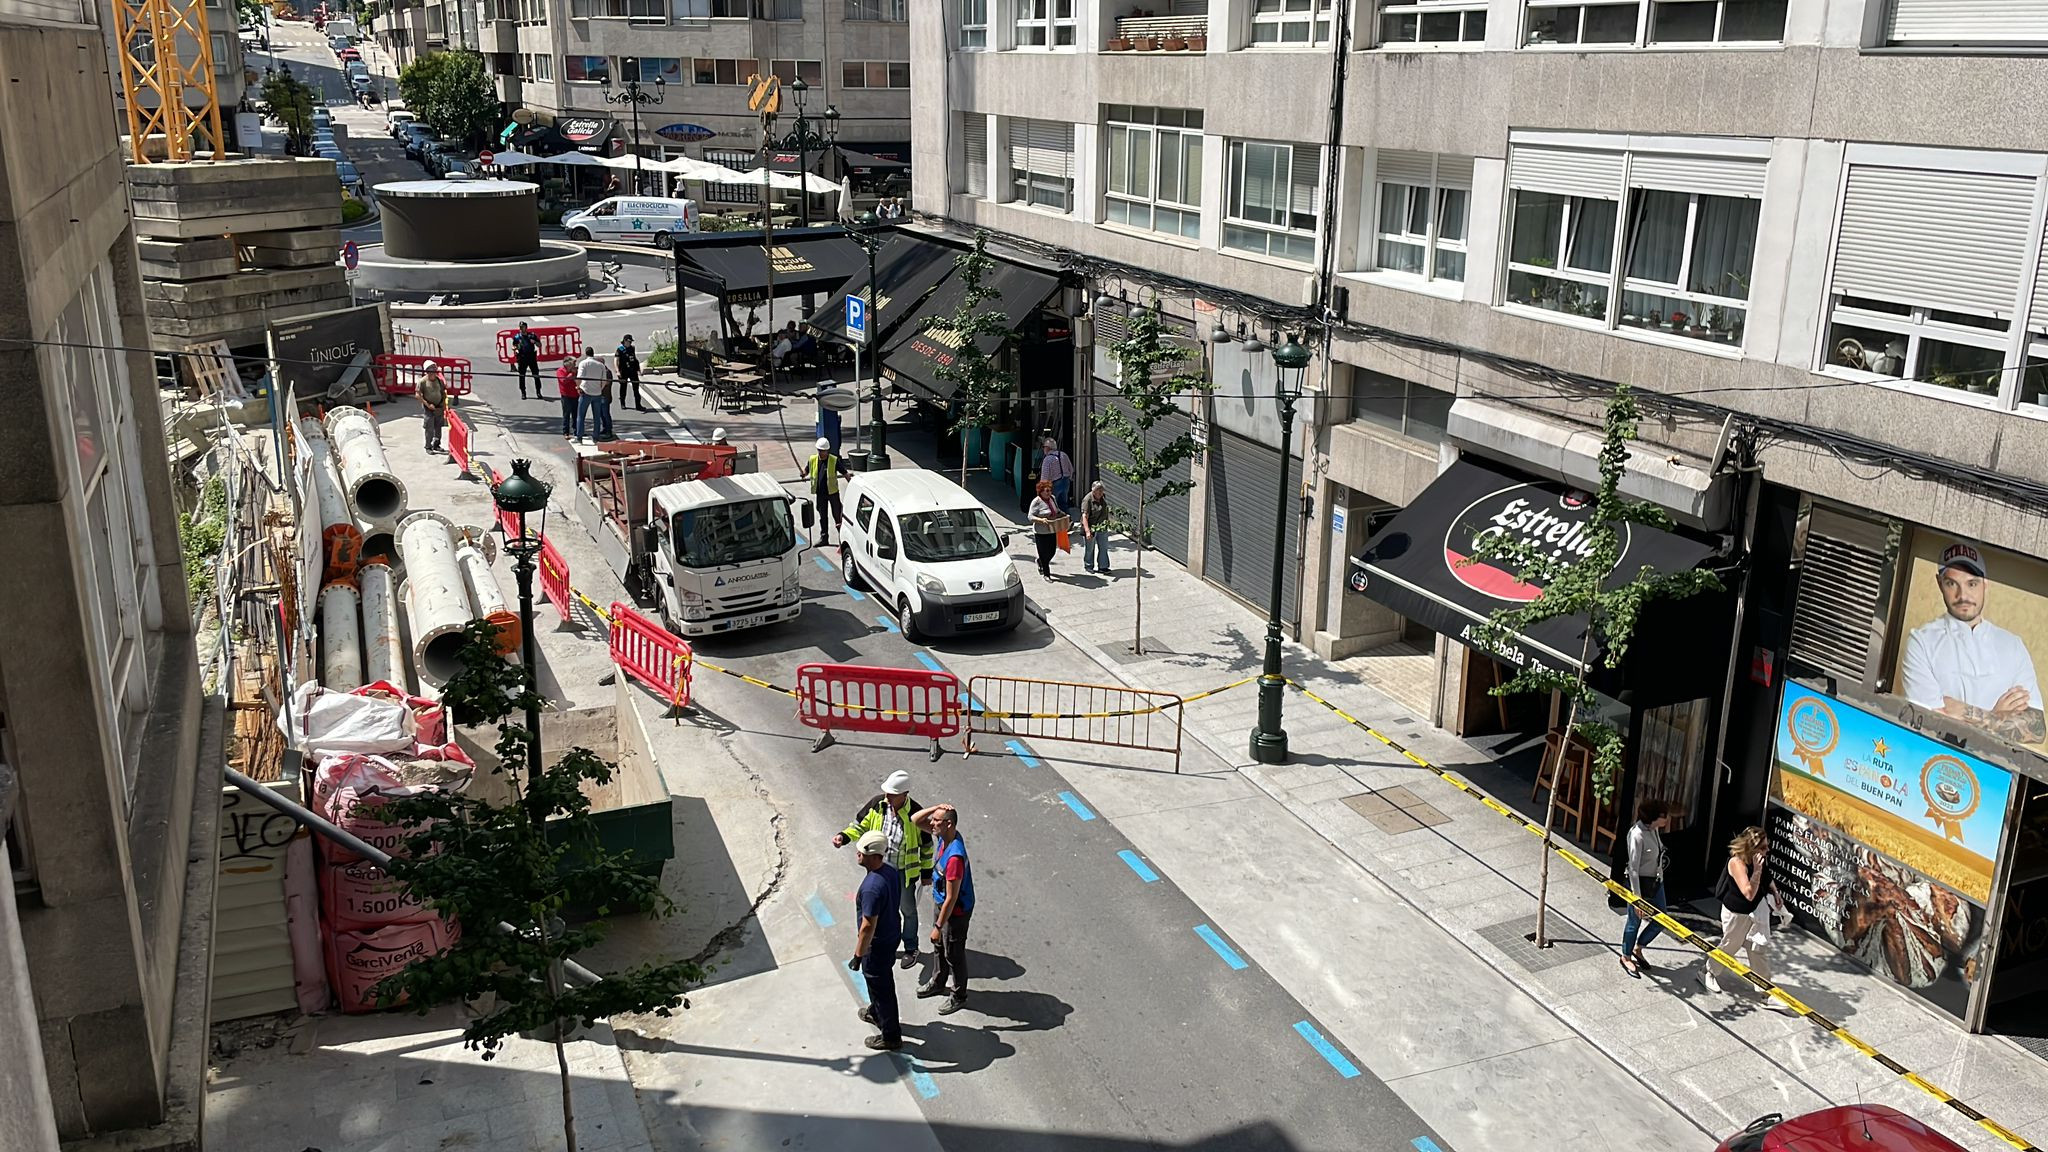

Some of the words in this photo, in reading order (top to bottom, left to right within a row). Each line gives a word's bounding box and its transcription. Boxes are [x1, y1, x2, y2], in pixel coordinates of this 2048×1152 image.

[569, 121, 598, 129] Estrella
[773, 256, 806, 265] ANQUE
[850, 300, 860, 324] P
[310, 342, 358, 363] ÜNIQUE
[910, 339, 937, 358] DESDE
[934, 351, 954, 366] 1890
[1872, 757, 1894, 774] RUTA
[1861, 781, 1884, 799] BUEN
[1885, 793, 1903, 808] PAN
[1771, 841, 1811, 867] HARINAS
[1775, 816, 1804, 837] PANES
[1804, 831, 1865, 868] ELABORADOS
[1795, 837, 1820, 857] MASA
[1769, 854, 1812, 884] BOLLERÍA
[345, 941, 425, 969] GarciVenta
